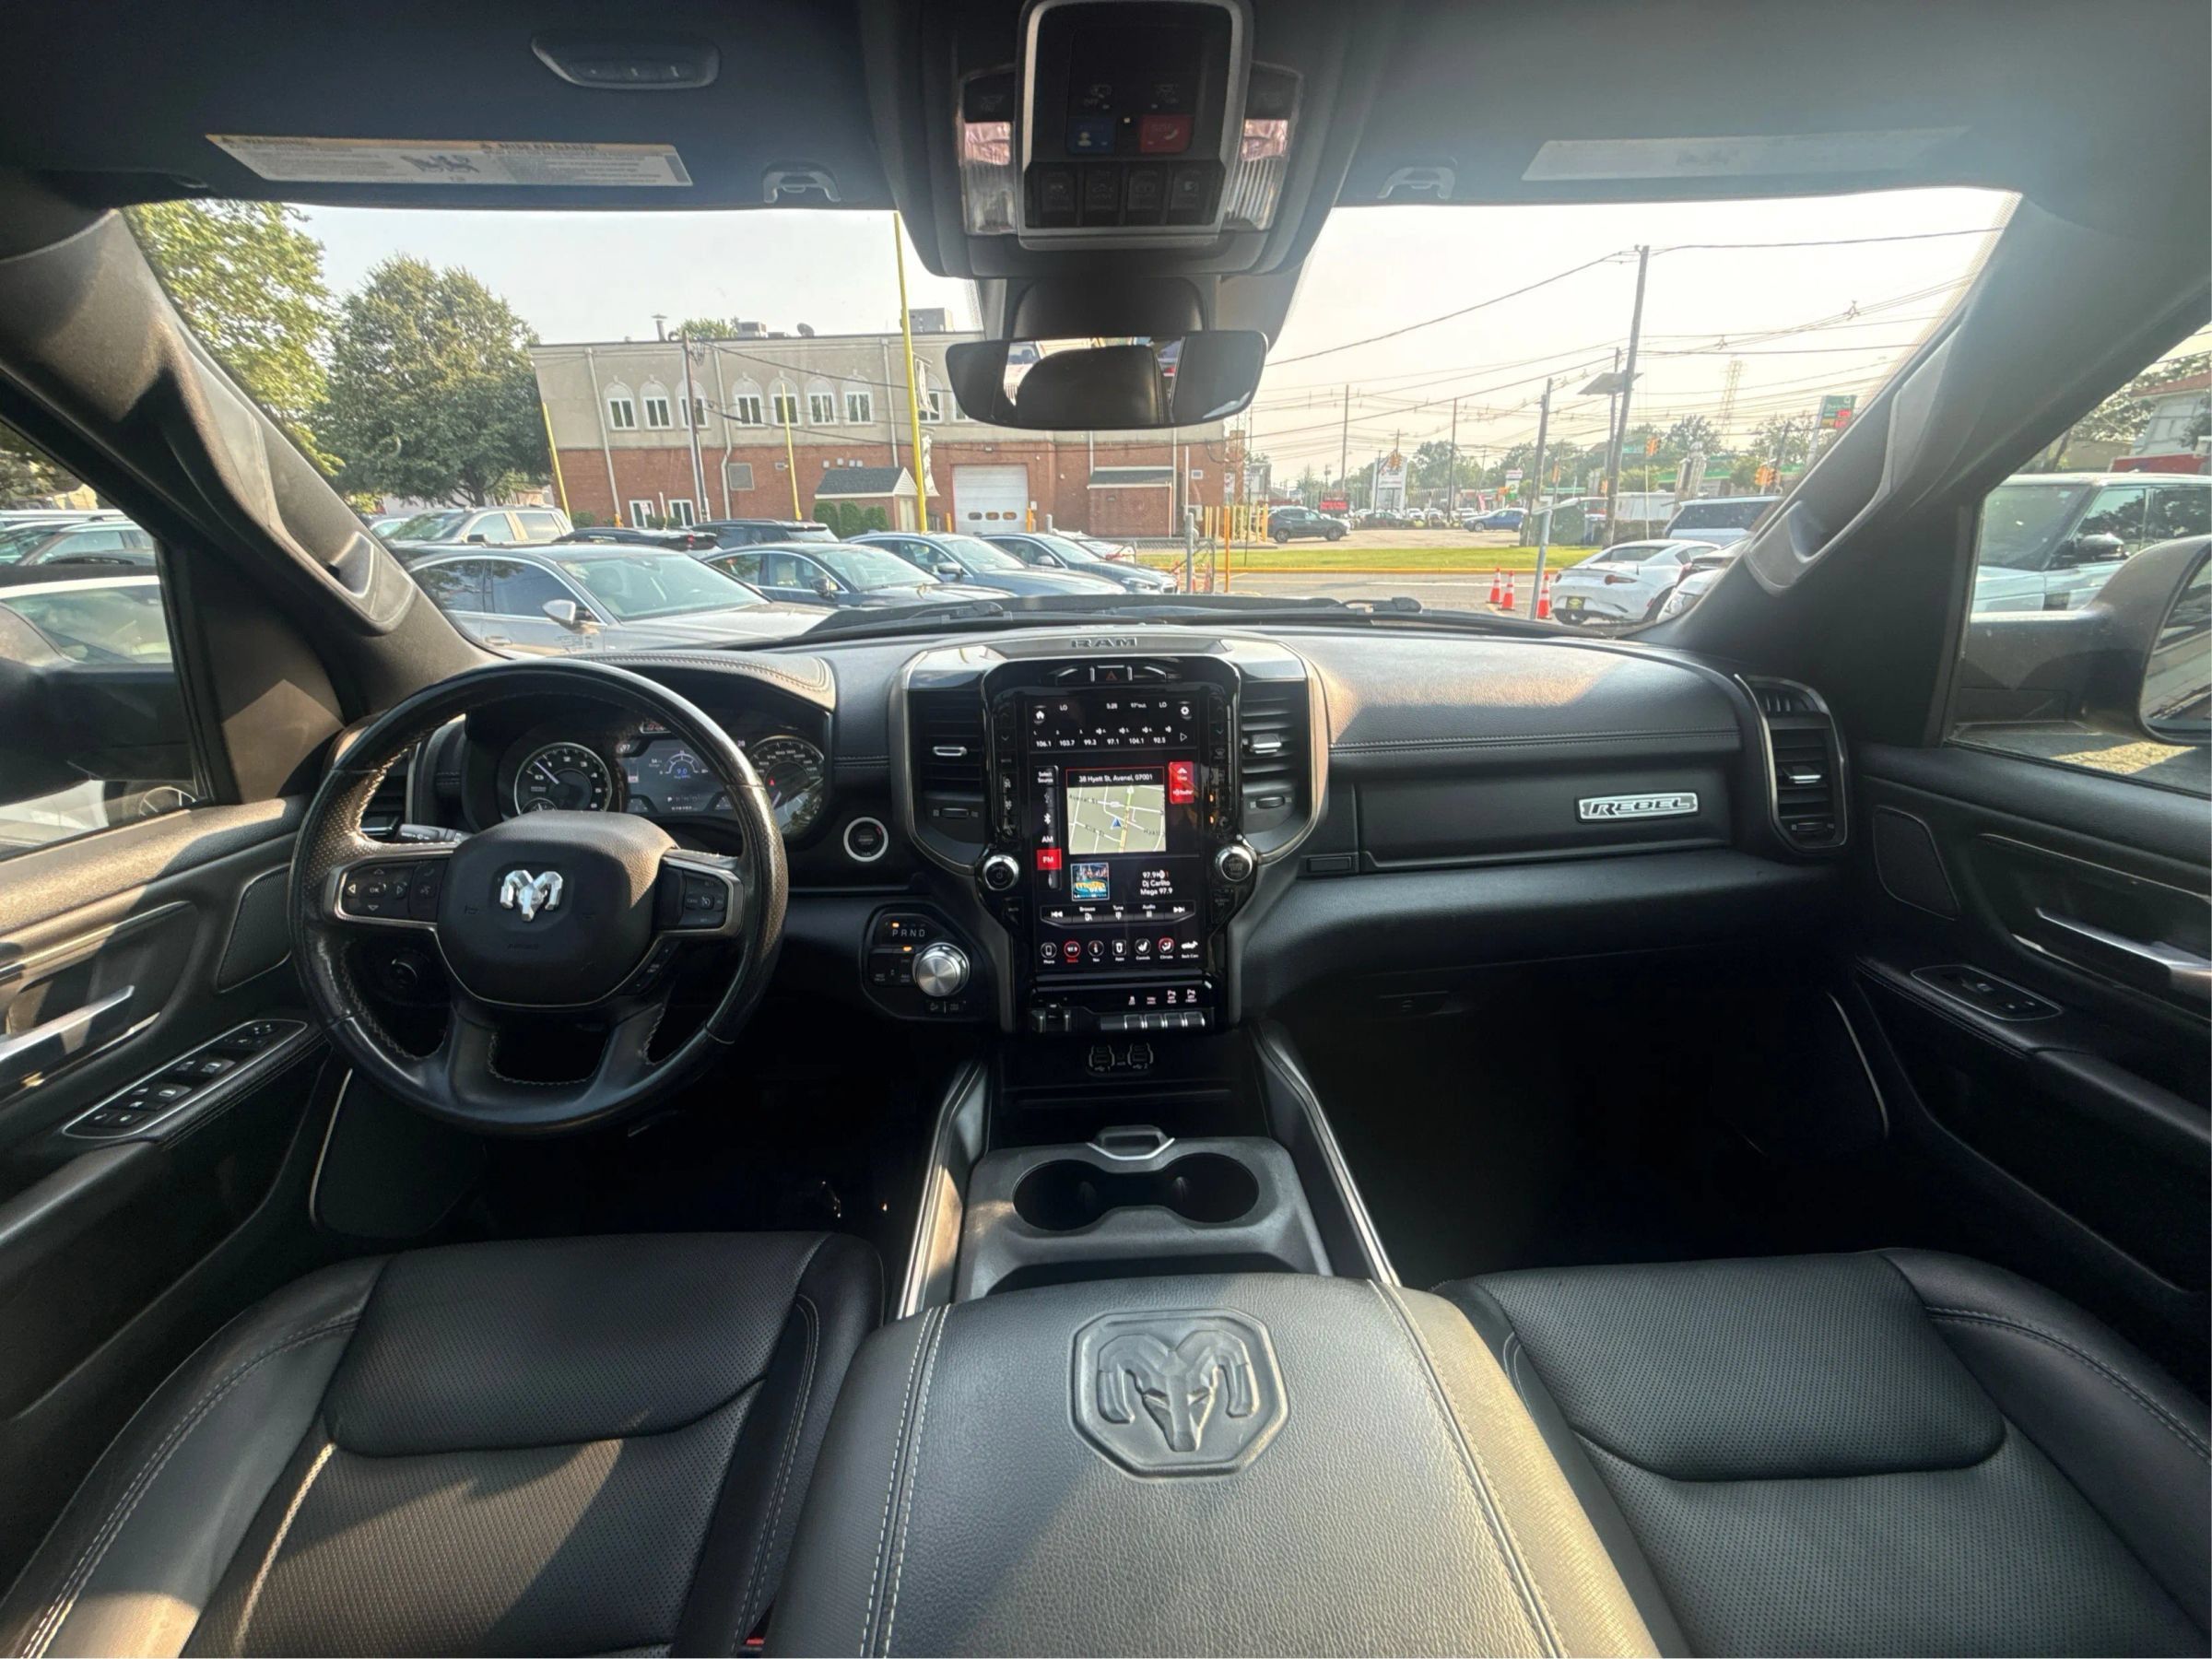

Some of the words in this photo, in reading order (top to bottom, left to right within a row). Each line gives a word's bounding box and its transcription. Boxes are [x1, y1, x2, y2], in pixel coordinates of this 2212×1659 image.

[1070, 637, 1137, 648] RAM
[1589, 798, 1690, 816] REBEL
[1140, 888, 1159, 896] Mega
